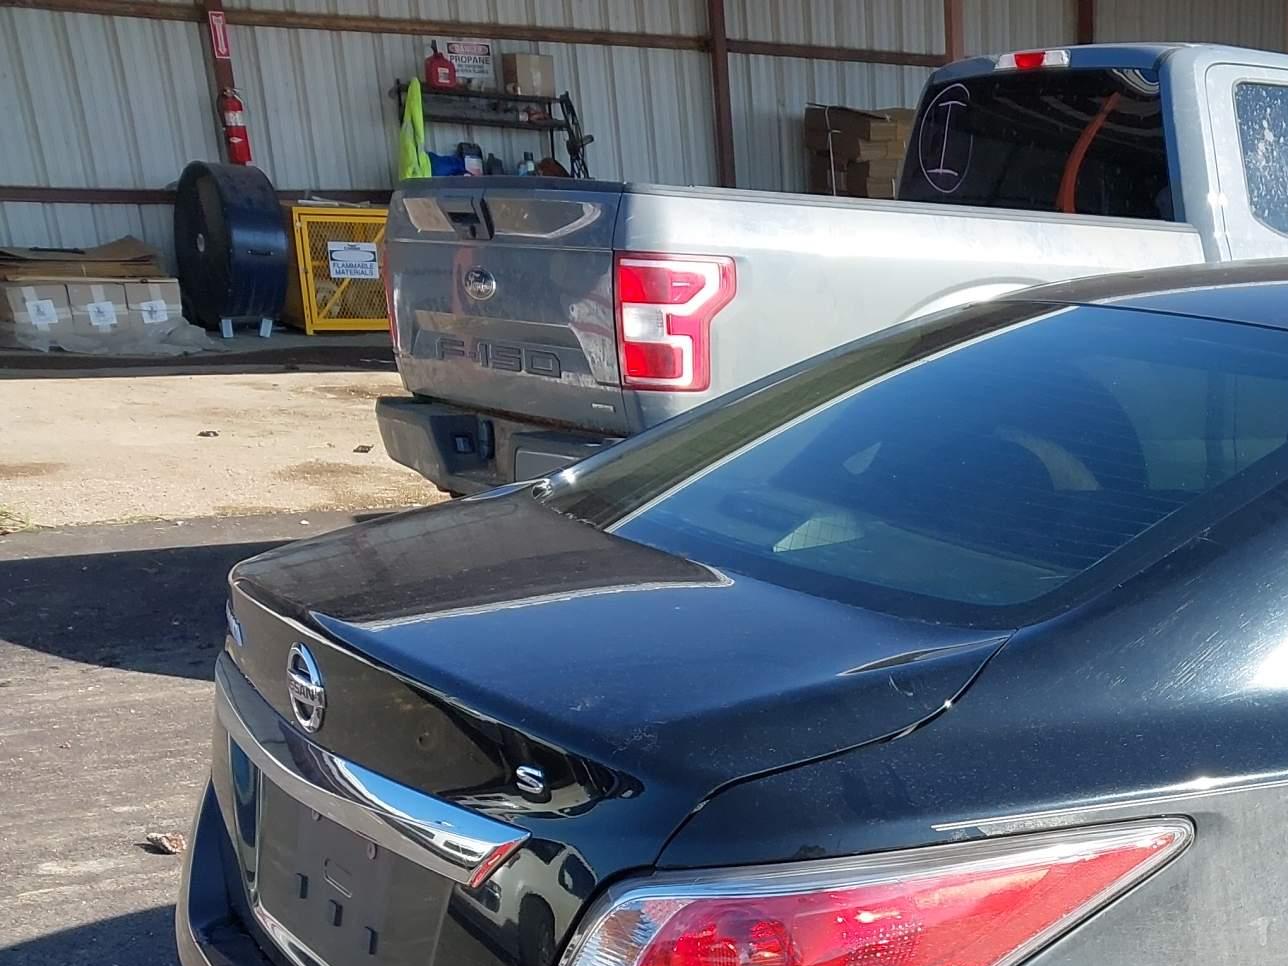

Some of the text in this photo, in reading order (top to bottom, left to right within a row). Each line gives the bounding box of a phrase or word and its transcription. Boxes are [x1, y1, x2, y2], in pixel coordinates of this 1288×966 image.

[449, 55, 491, 65] PROPANE
[435, 336, 563, 379] F-150
[516, 765, 544, 794] S
